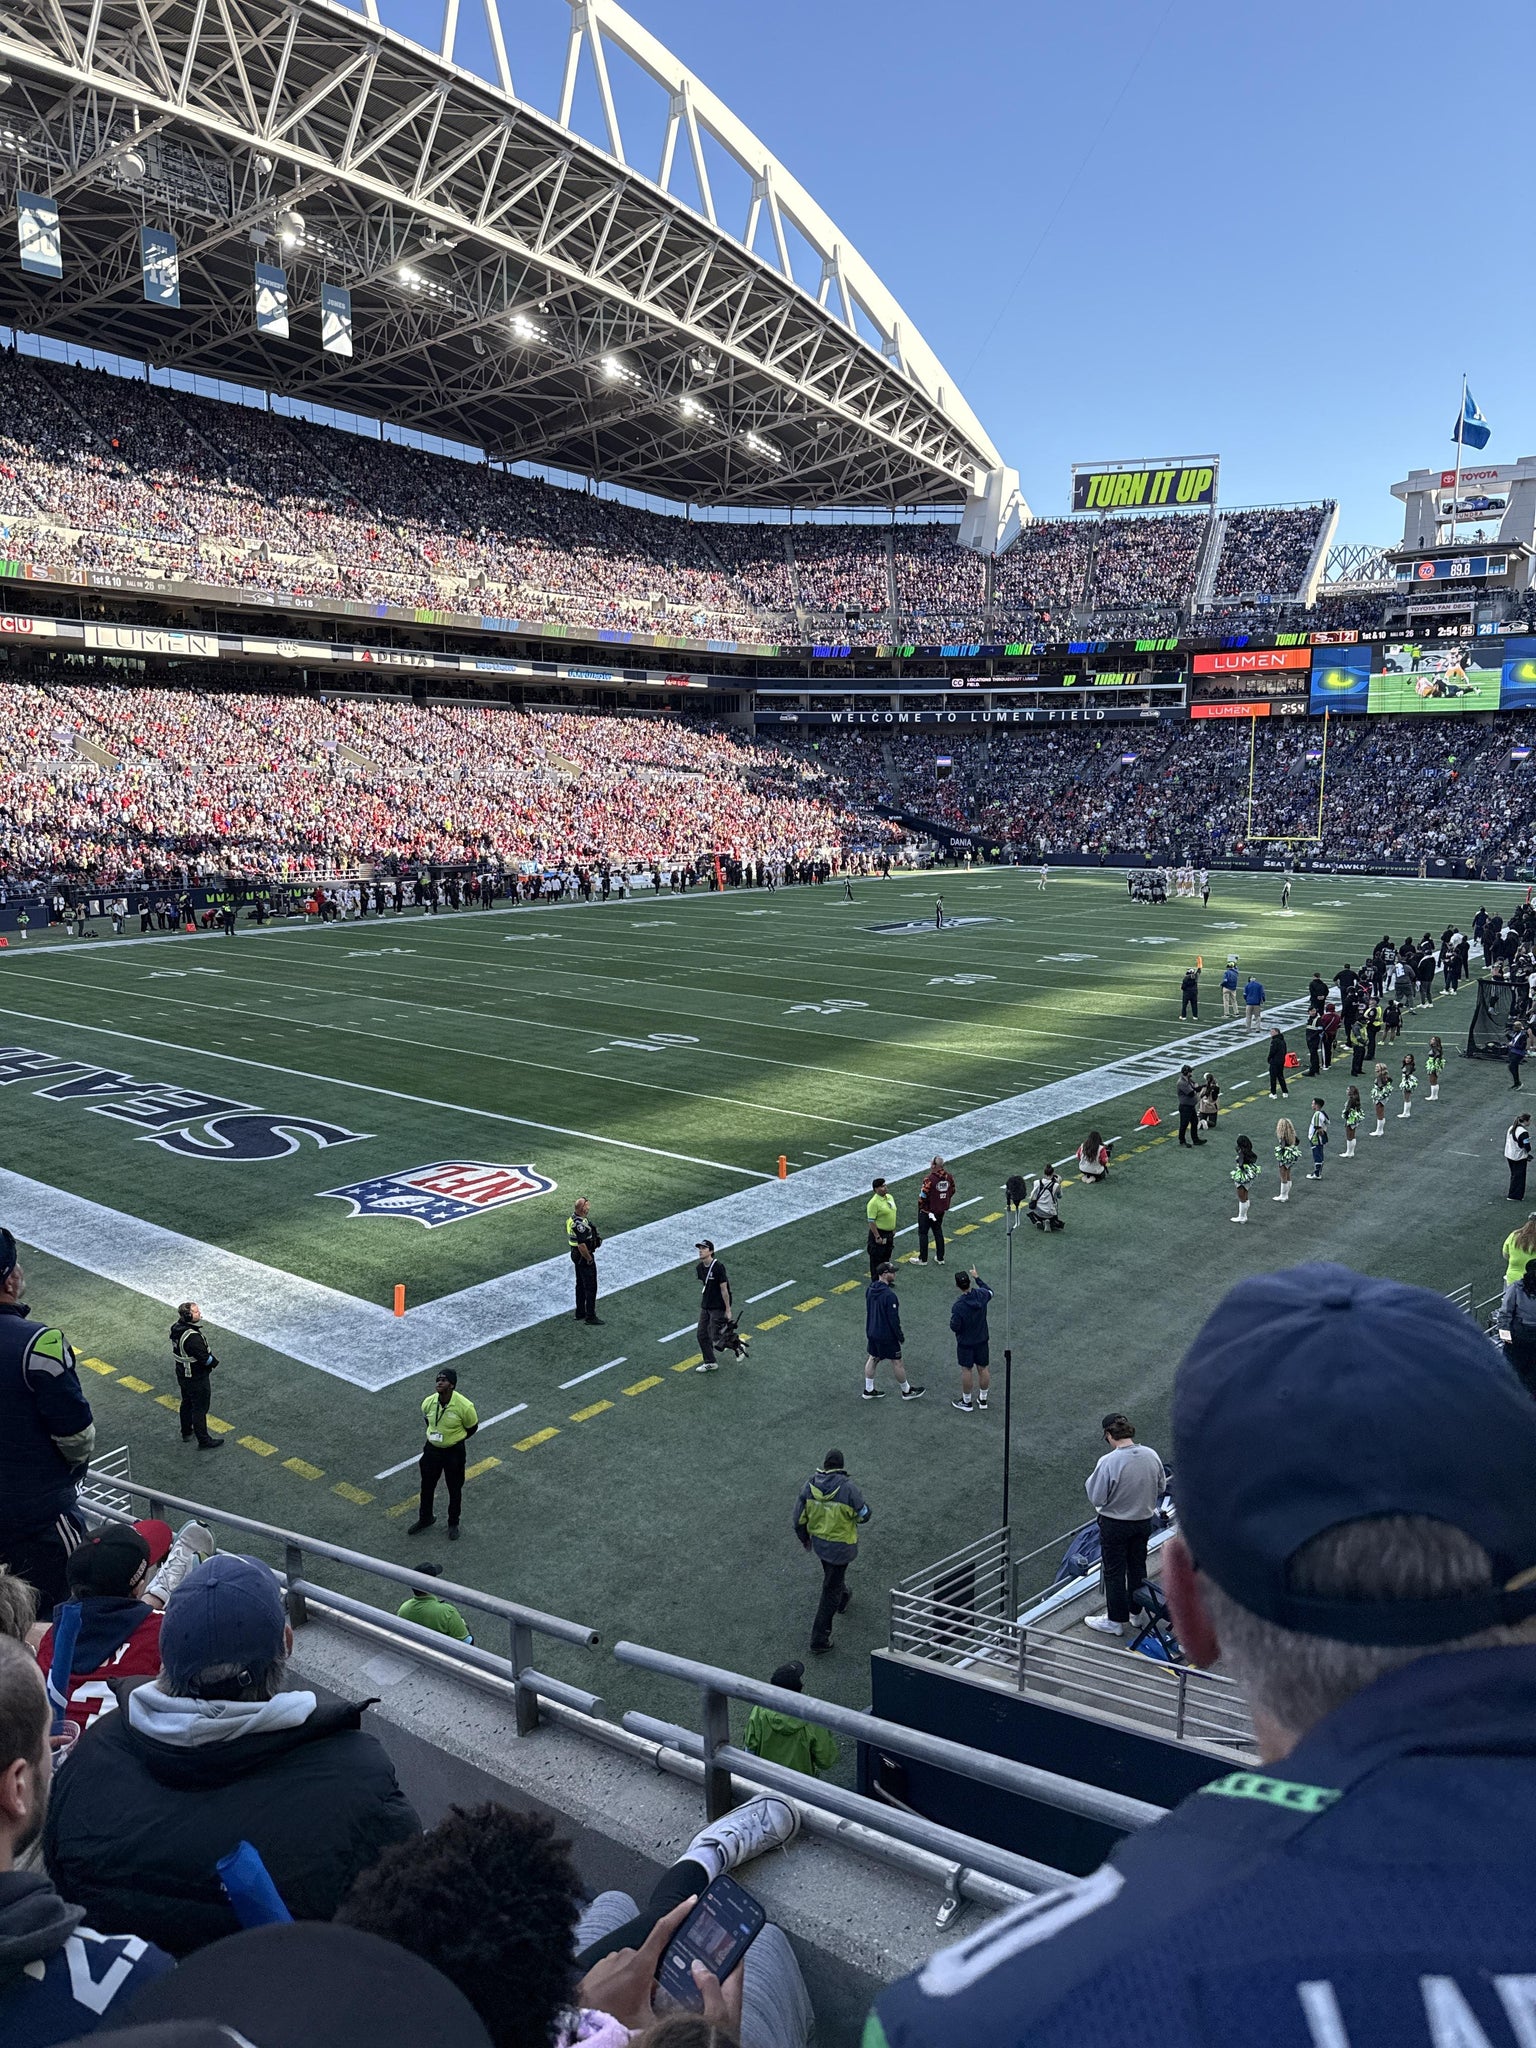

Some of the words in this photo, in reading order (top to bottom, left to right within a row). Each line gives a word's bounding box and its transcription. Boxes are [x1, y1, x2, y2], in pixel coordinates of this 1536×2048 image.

[257, 277, 285, 290] KENNEDY
[326, 299, 346, 310] JONES
[1460, 470, 1498, 481] TOYOTA
[1085, 472, 1149, 508] TURN
[1149, 470, 1176, 504] IT
[1175, 468, 1213, 503] UP
[1421, 566, 1432, 575] 76
[1450, 563, 1471, 576] 89.8
[70, 571, 83, 583] 21
[92, 575, 104, 585] 1st
[104, 576, 111, 585] &
[112, 577, 122, 587] 10
[295, 598, 314, 608] 0:18
[1344, 632, 1354, 641] 21
[1362, 631, 1372, 639] 1st
[1372, 631, 1378, 639] &
[1378, 631, 1386, 639] 10
[1425, 628, 1430, 636] 3
[1437, 626, 1458, 637] 2:54
[1462, 625, 1473, 635] 25
[1480, 624, 1492, 635] 26
[96, 625, 208, 655] LUMEN
[1135, 639, 1156, 651] TURN
[1156, 638, 1165, 651] IT
[1165, 638, 1178, 651] UP
[1275, 633, 1298, 646] TURN
[1297, 633, 1307, 645] IT
[812, 645, 832, 657] TURN
[832, 645, 840, 657] IT
[840, 644, 851, 657] UP
[903, 645, 915, 657] UP
[940, 645, 960, 657] TURN
[960, 645, 968, 657] IT
[968, 644, 980, 657] UP
[1004, 644, 1024, 656] TURN
[1024, 644, 1033, 656] IT
[378, 651, 428, 666] DELTA
[1214, 654, 1285, 669] LUMEN
[1208, 706, 1251, 715] LUMEN
[1280, 703, 1305, 714] 2:54
[831, 713, 921, 723] WELCOME
[935, 713, 957, 722] TO
[970, 711, 1034, 722] LUMEN
[1049, 710, 1105, 721] FIELD
[950, 838, 972, 846] DANIA
[1263, 860, 1306, 868] SEATE
[1384, 952, 1395, 960] 33
[790, 998, 870, 1015] 20
[609, 1033, 700, 1052] 10
[408, 1165, 535, 1205] NFL
